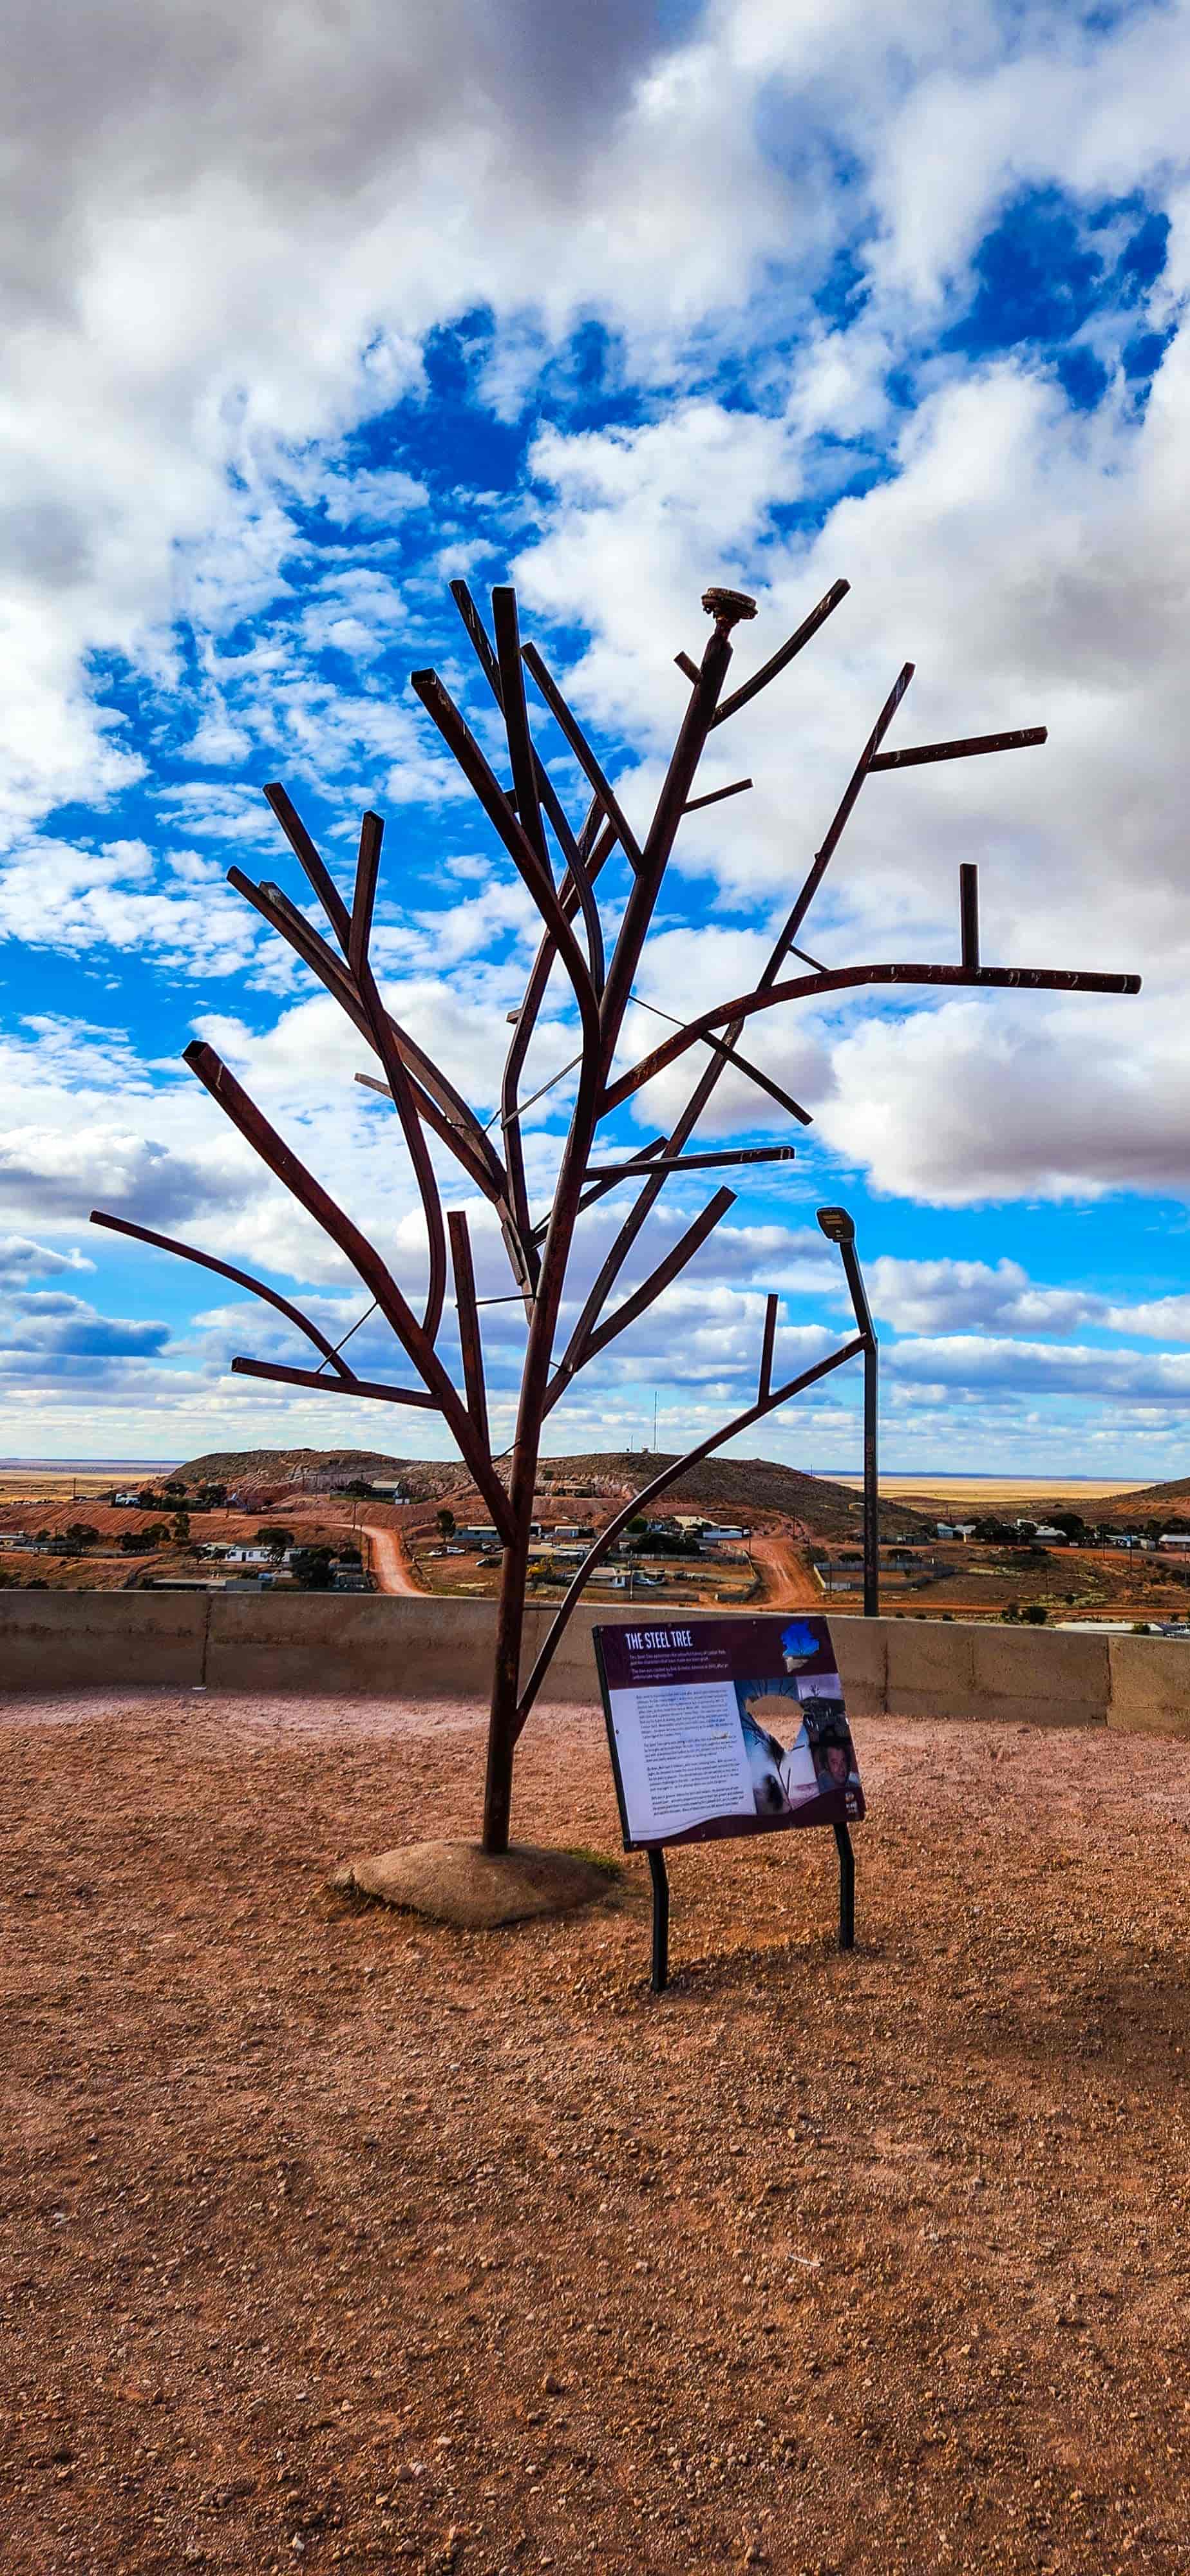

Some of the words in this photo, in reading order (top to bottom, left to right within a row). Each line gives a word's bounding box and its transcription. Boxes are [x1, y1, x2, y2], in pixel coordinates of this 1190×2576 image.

[625, 1633, 644, 1649] THE
[645, 1631, 671, 1649] STEEL
[671, 1630, 693, 1647] TREE
